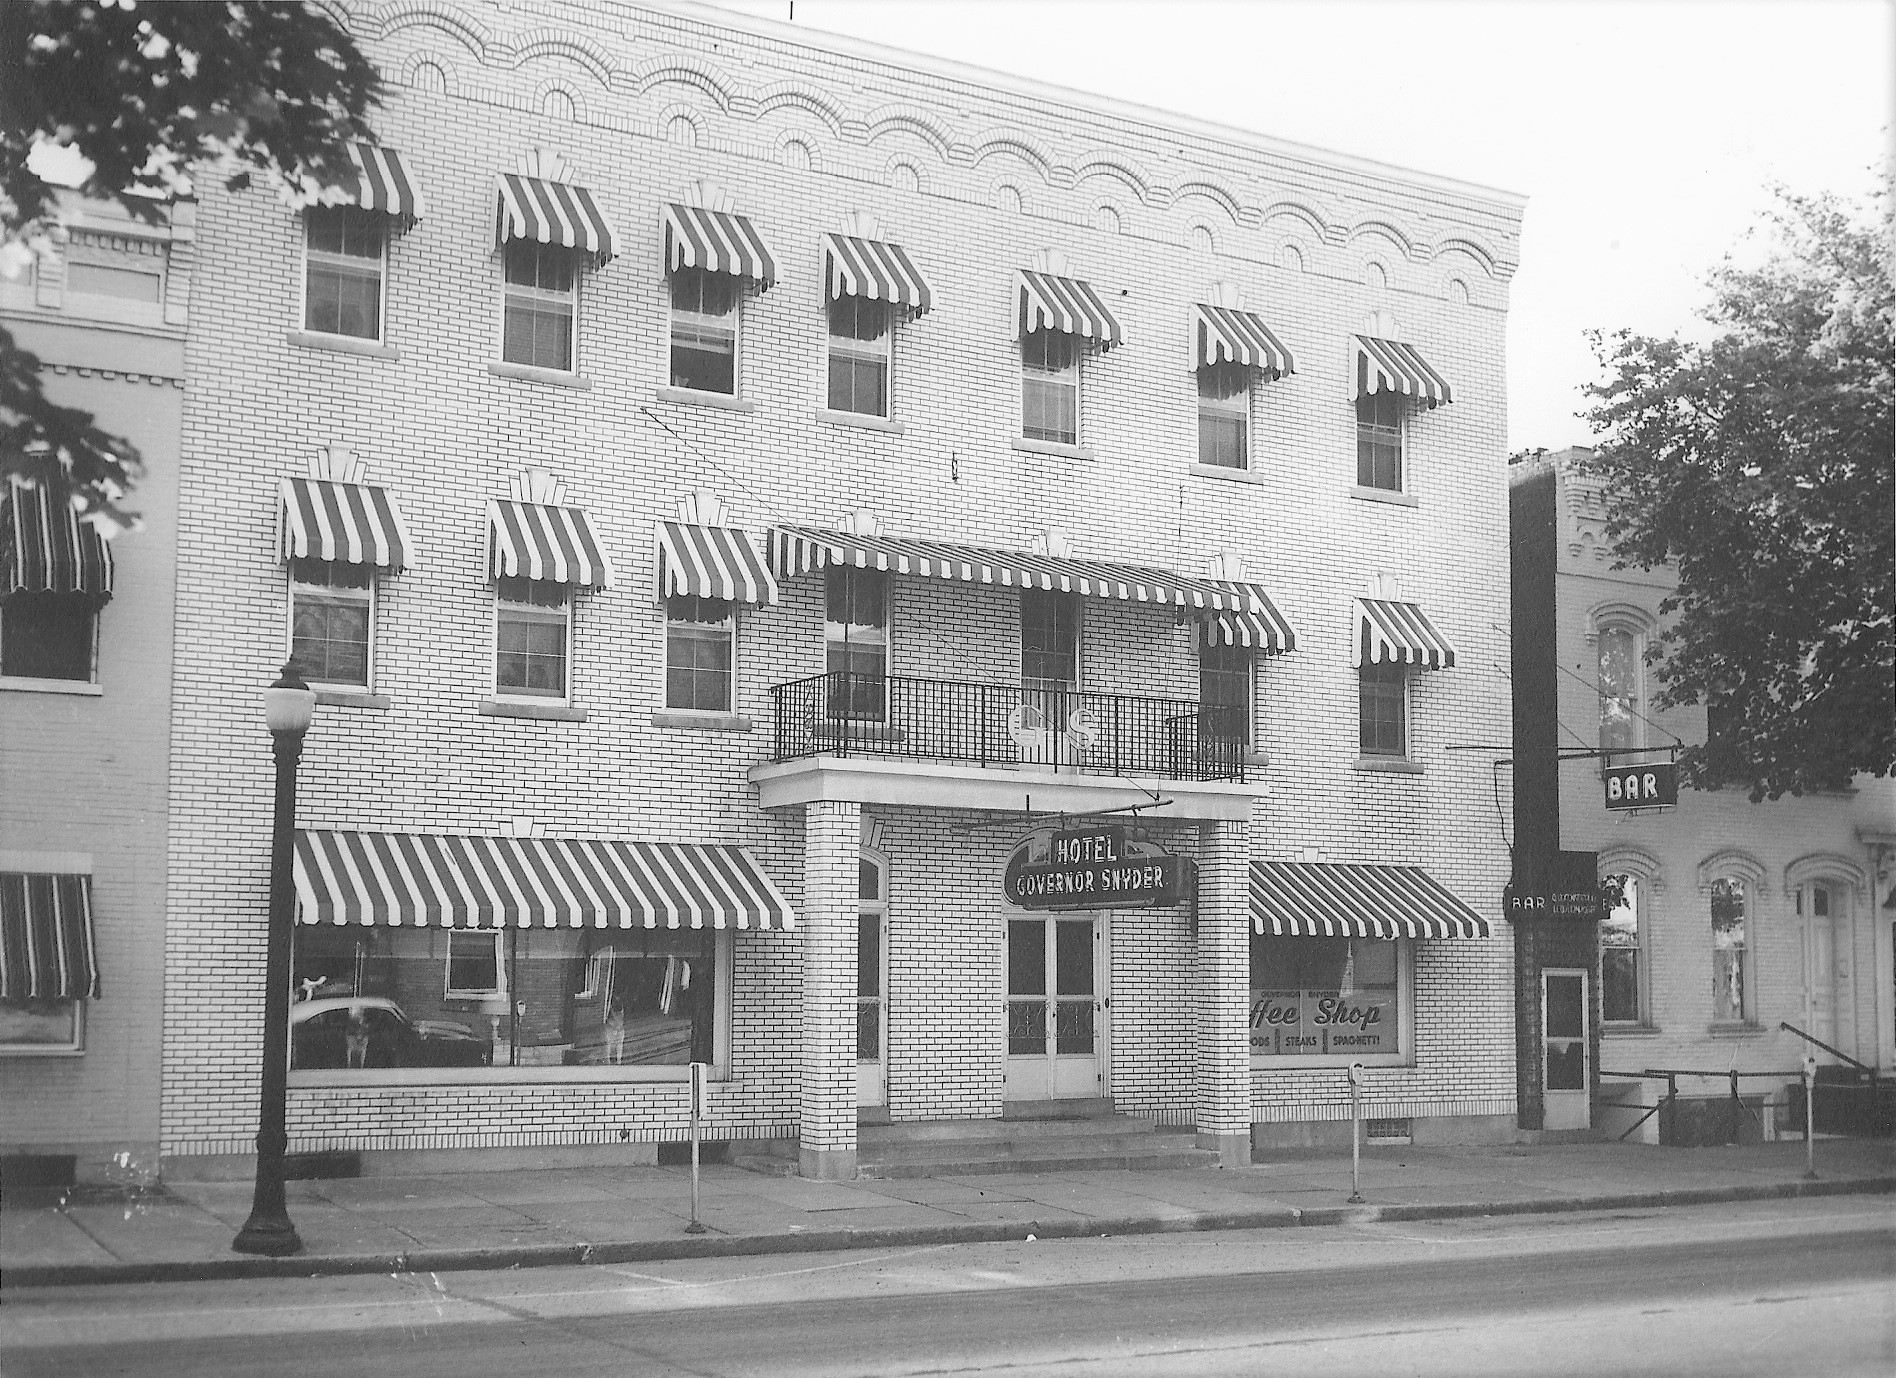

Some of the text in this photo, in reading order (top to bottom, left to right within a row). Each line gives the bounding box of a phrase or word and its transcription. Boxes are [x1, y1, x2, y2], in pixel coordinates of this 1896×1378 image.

[1607, 773, 1658, 800] BAR
[1056, 834, 1118, 864] HOTEL
[1016, 865, 1164, 896] GOVERNOR SNYDER
[1512, 896, 1545, 910] BAR
[1250, 998, 1381, 1031] ffee Shop
[1285, 1036, 1317, 1047] STEAKS
[1332, 1035, 1380, 1046] SPAGHETTI
